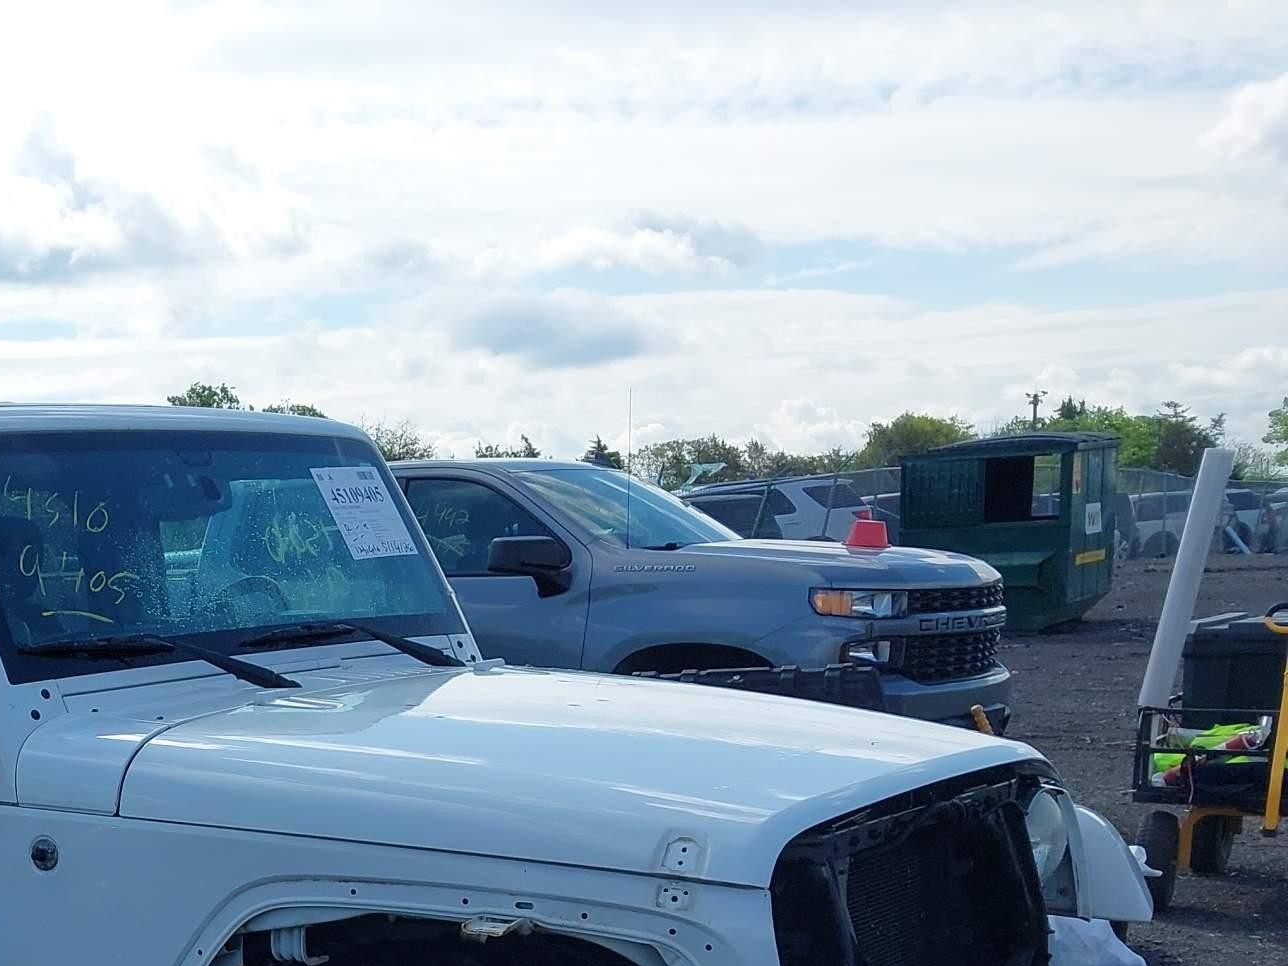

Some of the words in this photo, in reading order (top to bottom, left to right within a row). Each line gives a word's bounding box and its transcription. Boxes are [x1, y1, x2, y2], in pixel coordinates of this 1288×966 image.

[4, 475, 109, 533] 4510
[330, 486, 385, 504] 45109405
[613, 564, 696, 573] SILVERADO
